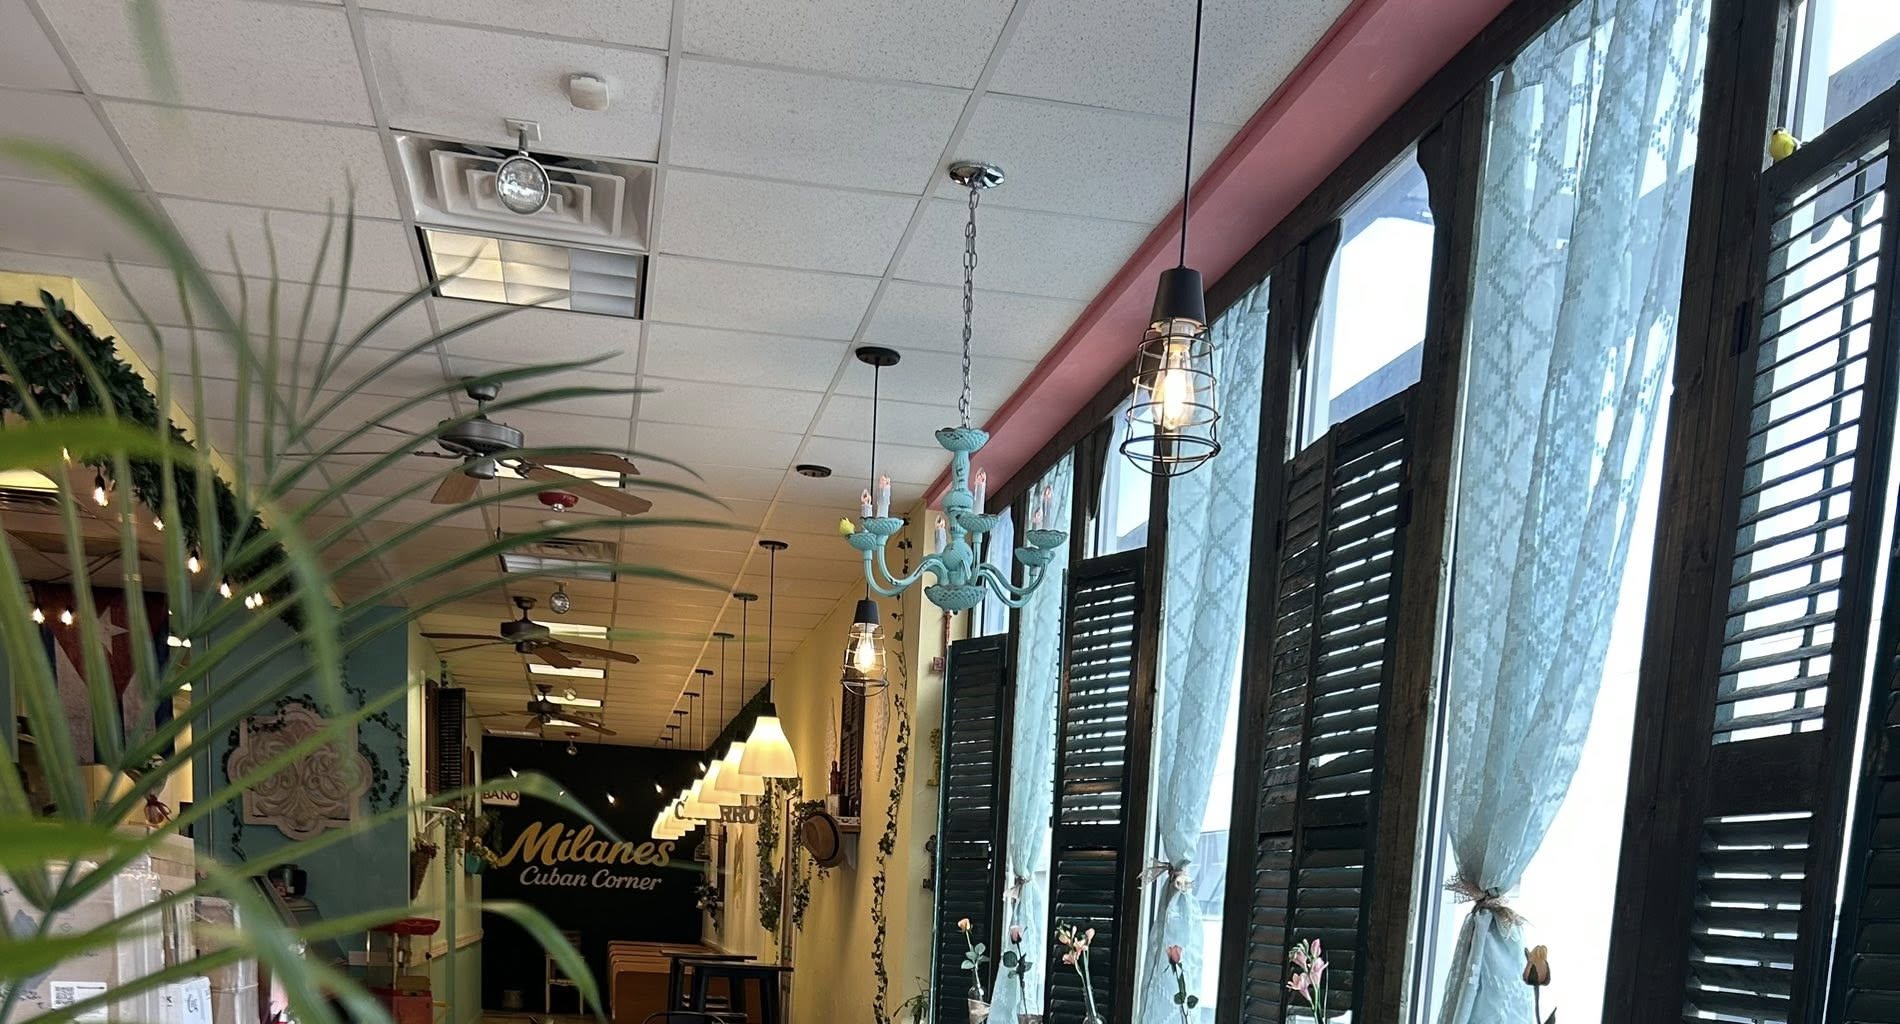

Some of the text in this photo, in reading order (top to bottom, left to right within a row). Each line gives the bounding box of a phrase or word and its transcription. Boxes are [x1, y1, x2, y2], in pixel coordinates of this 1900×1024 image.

[497, 821, 676, 867] Milanes
[520, 866, 662, 891] Cuban Corner
